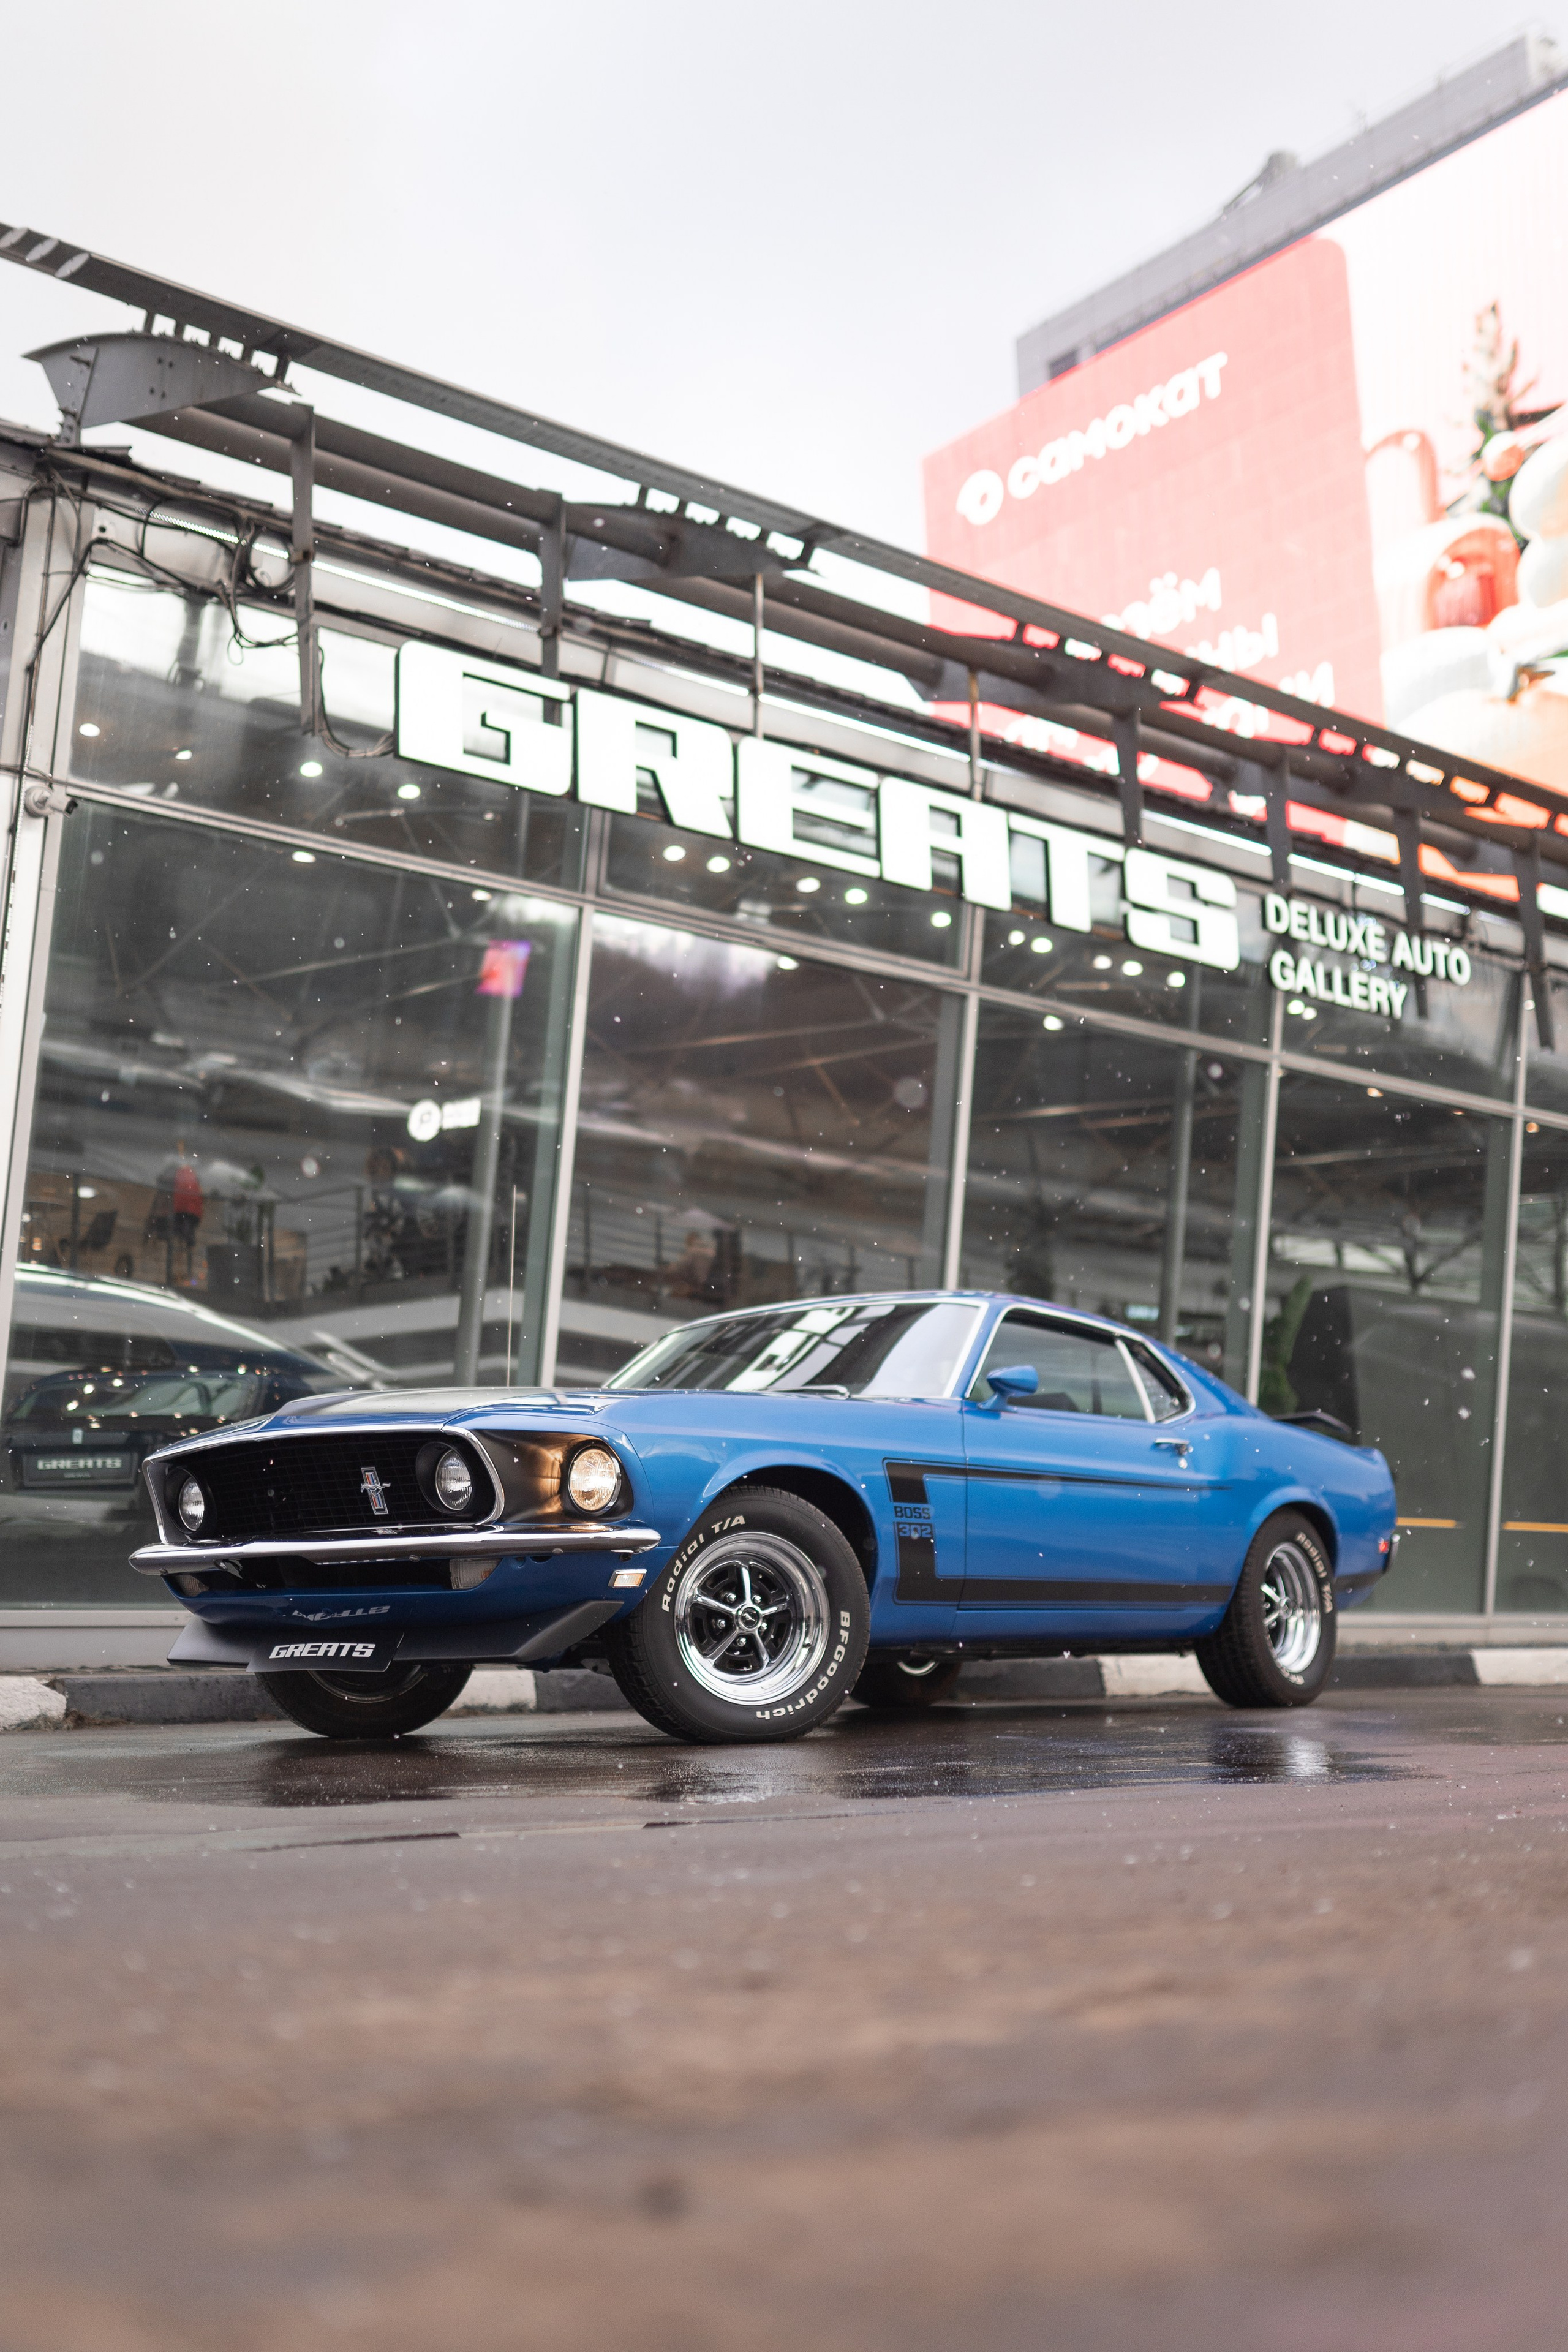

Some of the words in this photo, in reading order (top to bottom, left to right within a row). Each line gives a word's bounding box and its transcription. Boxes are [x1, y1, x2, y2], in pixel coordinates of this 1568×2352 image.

[397, 639, 1240, 971] GREATS
[1264, 892, 1387, 963] DELUXE
[1391, 930, 1471, 986] AUTO
[1269, 949, 1408, 1020] GALLERY
[37, 1458, 122, 1471] GREATS
[894, 1506, 931, 1520] BOSS
[898, 1523, 932, 1538] 302
[662, 1533, 704, 1613] Radial
[711, 1515, 746, 1534] T/A
[268, 1642, 376, 1659] GREATS
[756, 1610, 851, 1720] BFGoodrich
